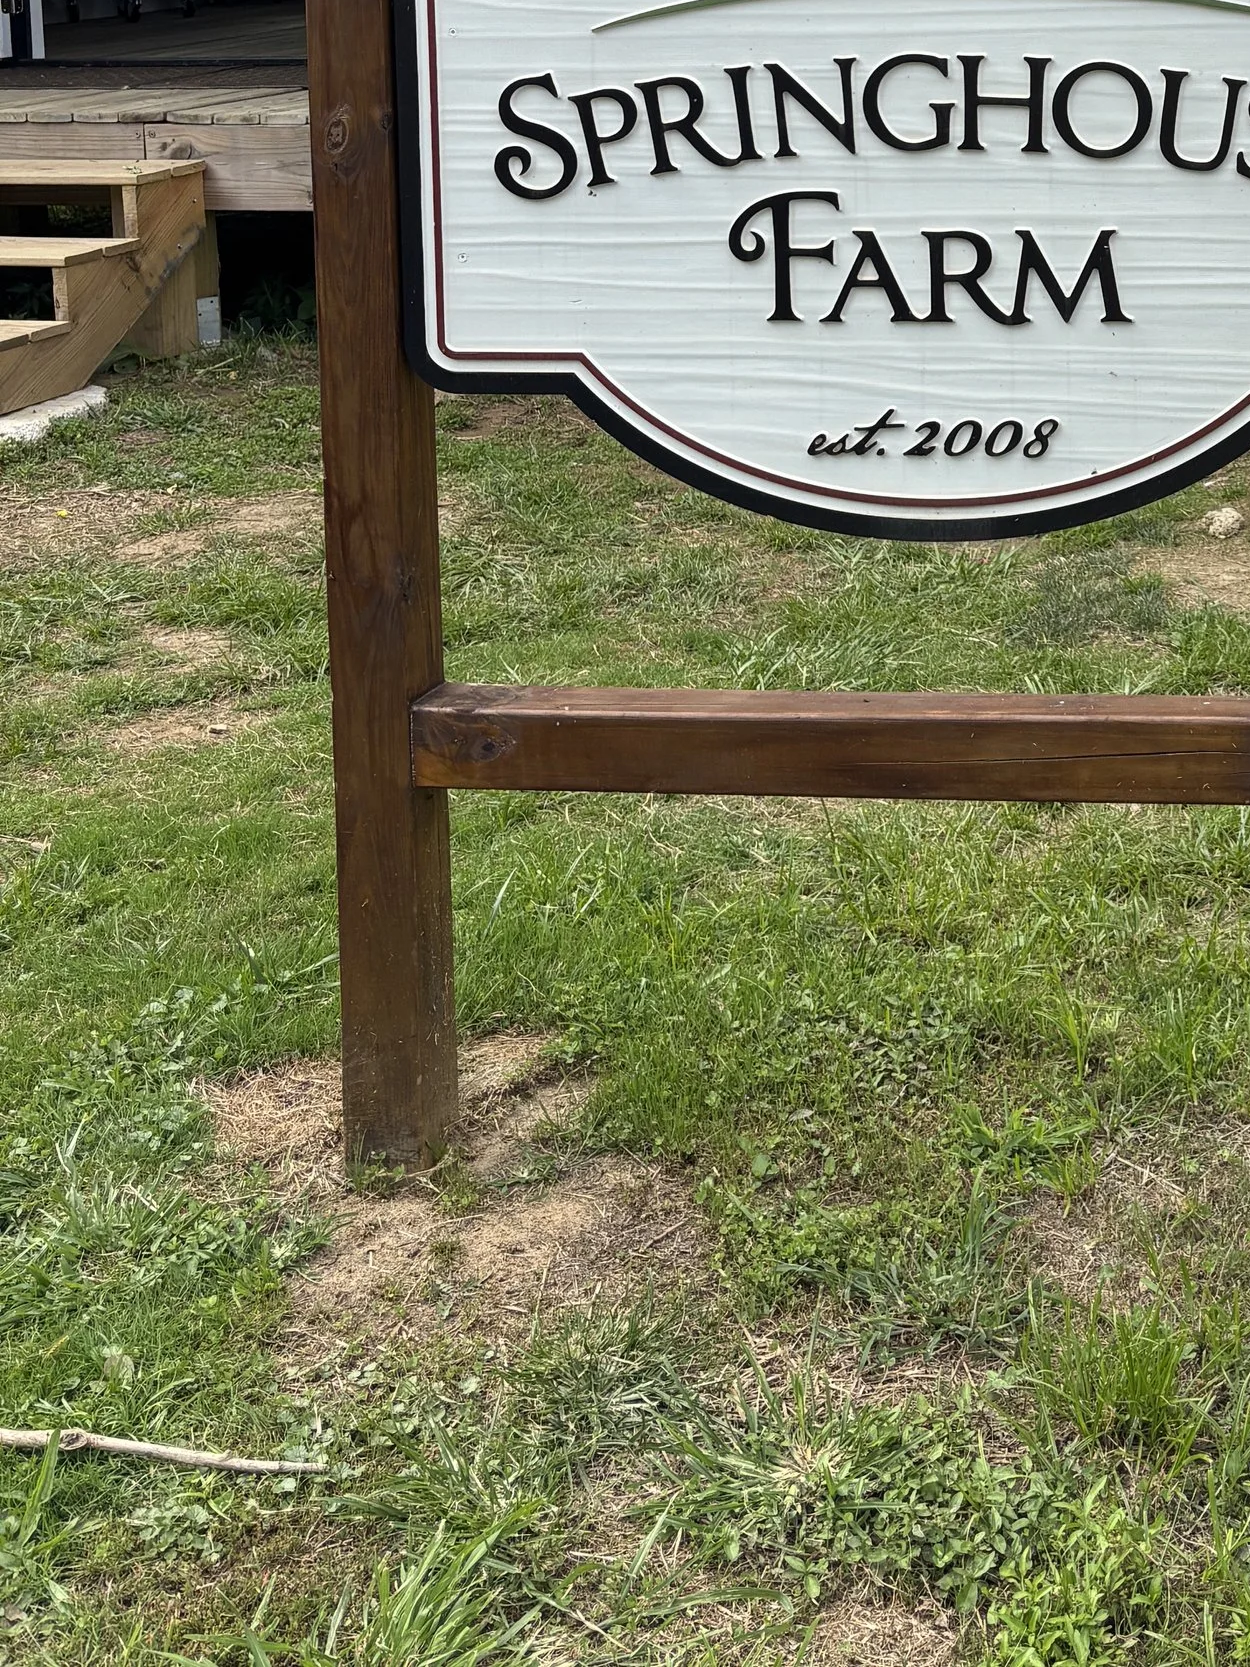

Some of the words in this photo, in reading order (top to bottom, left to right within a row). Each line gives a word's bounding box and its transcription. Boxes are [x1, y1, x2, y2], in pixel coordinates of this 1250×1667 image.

[729, 191, 1133, 325] FARM
[807, 408, 904, 456] est.
[903, 419, 1059, 458] 2008
